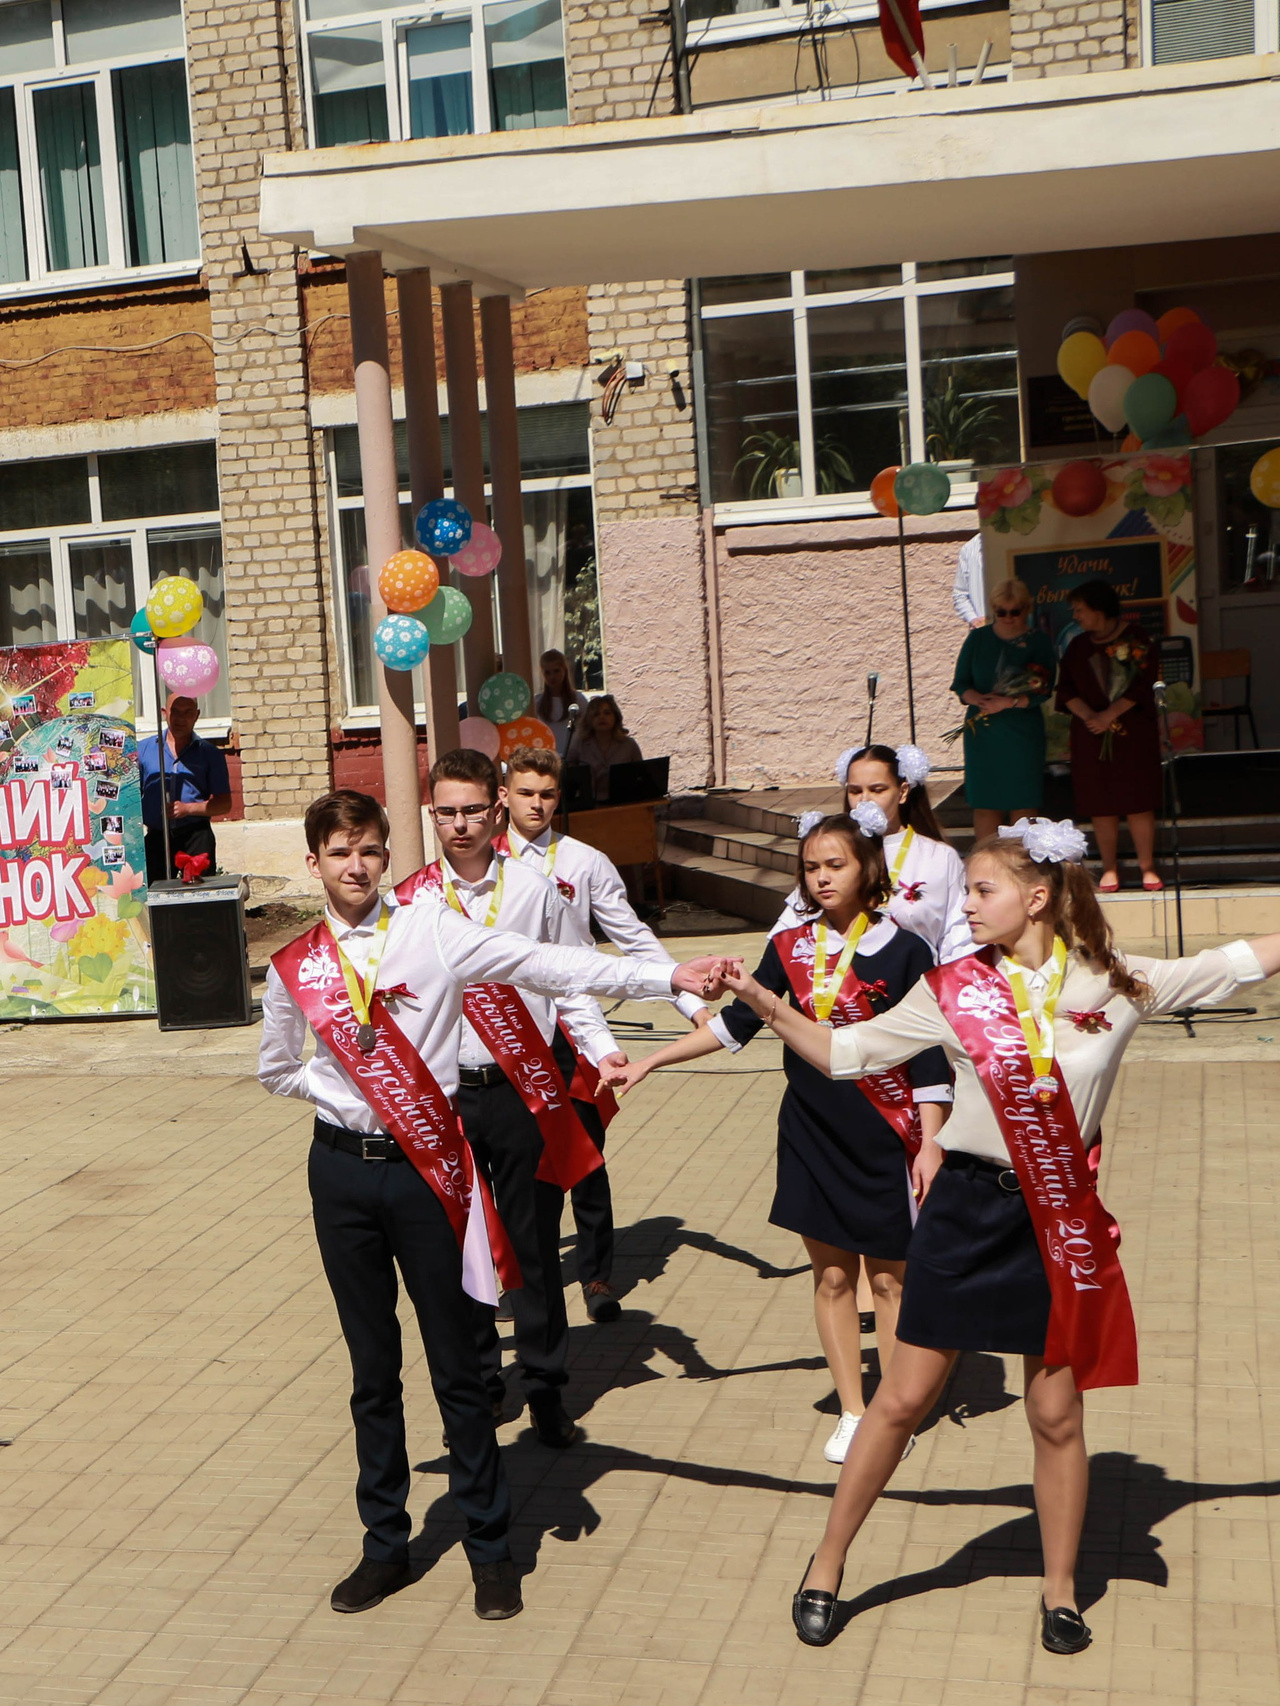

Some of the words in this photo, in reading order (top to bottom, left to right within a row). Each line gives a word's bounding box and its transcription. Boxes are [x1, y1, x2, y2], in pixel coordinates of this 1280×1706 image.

[1054, 555, 1114, 576] Удачи,
[504, 1000, 522, 1030] Илья
[374, 1023, 417, 1086] Кураксин
[520, 1057, 562, 1111] 2021
[984, 1024, 1071, 1211] Выпускник
[1055, 1217, 1102, 1293] 2021
[1056, 1142, 1078, 1189] Ирина
